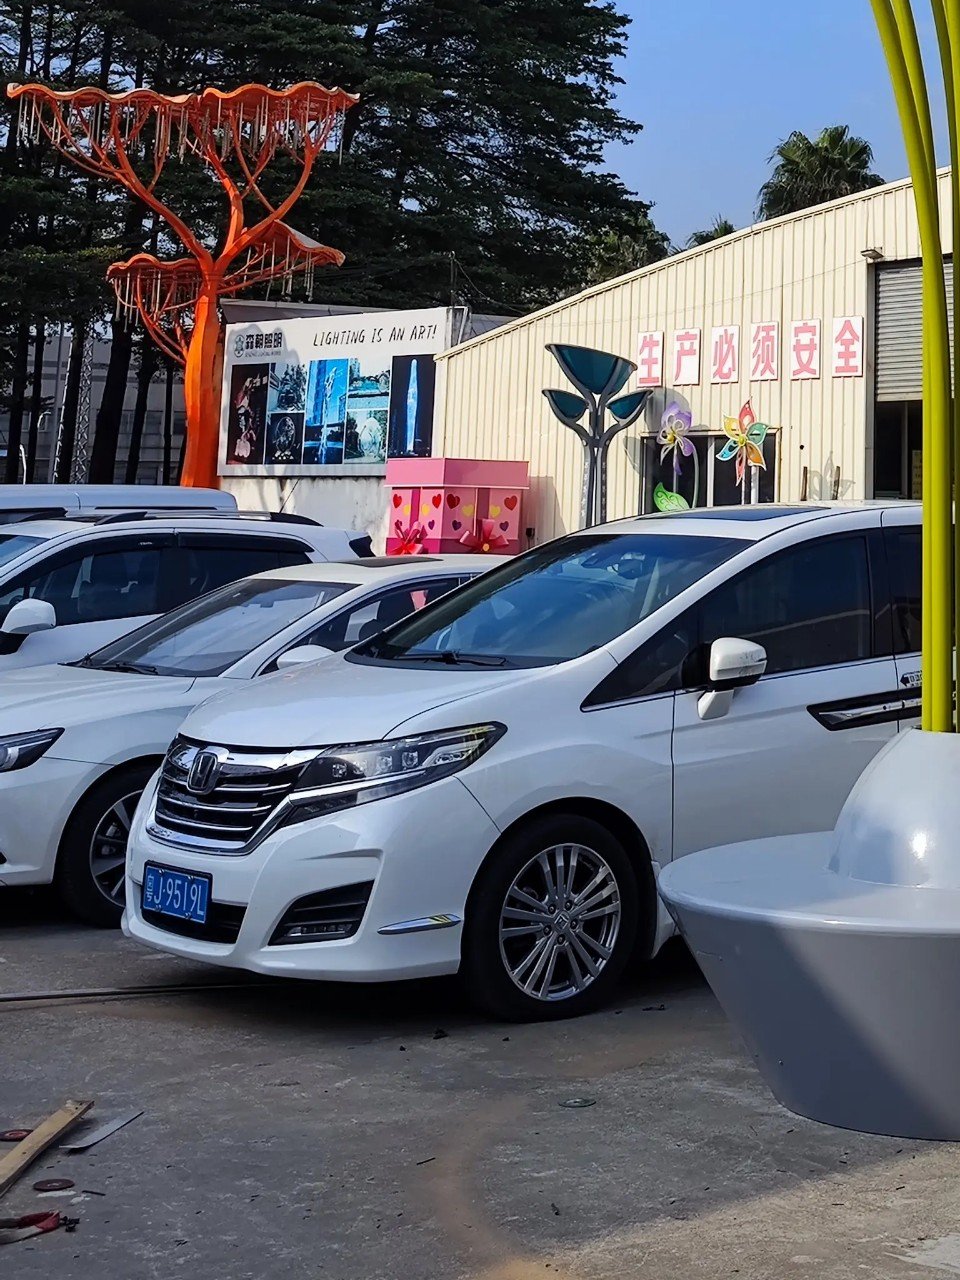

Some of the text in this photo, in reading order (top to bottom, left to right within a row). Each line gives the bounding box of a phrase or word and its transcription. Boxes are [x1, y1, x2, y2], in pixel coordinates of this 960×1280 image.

[313, 324, 438, 347] LIGHTING IS AN ART!
[638, 319, 860, 385] 生产必须安全
